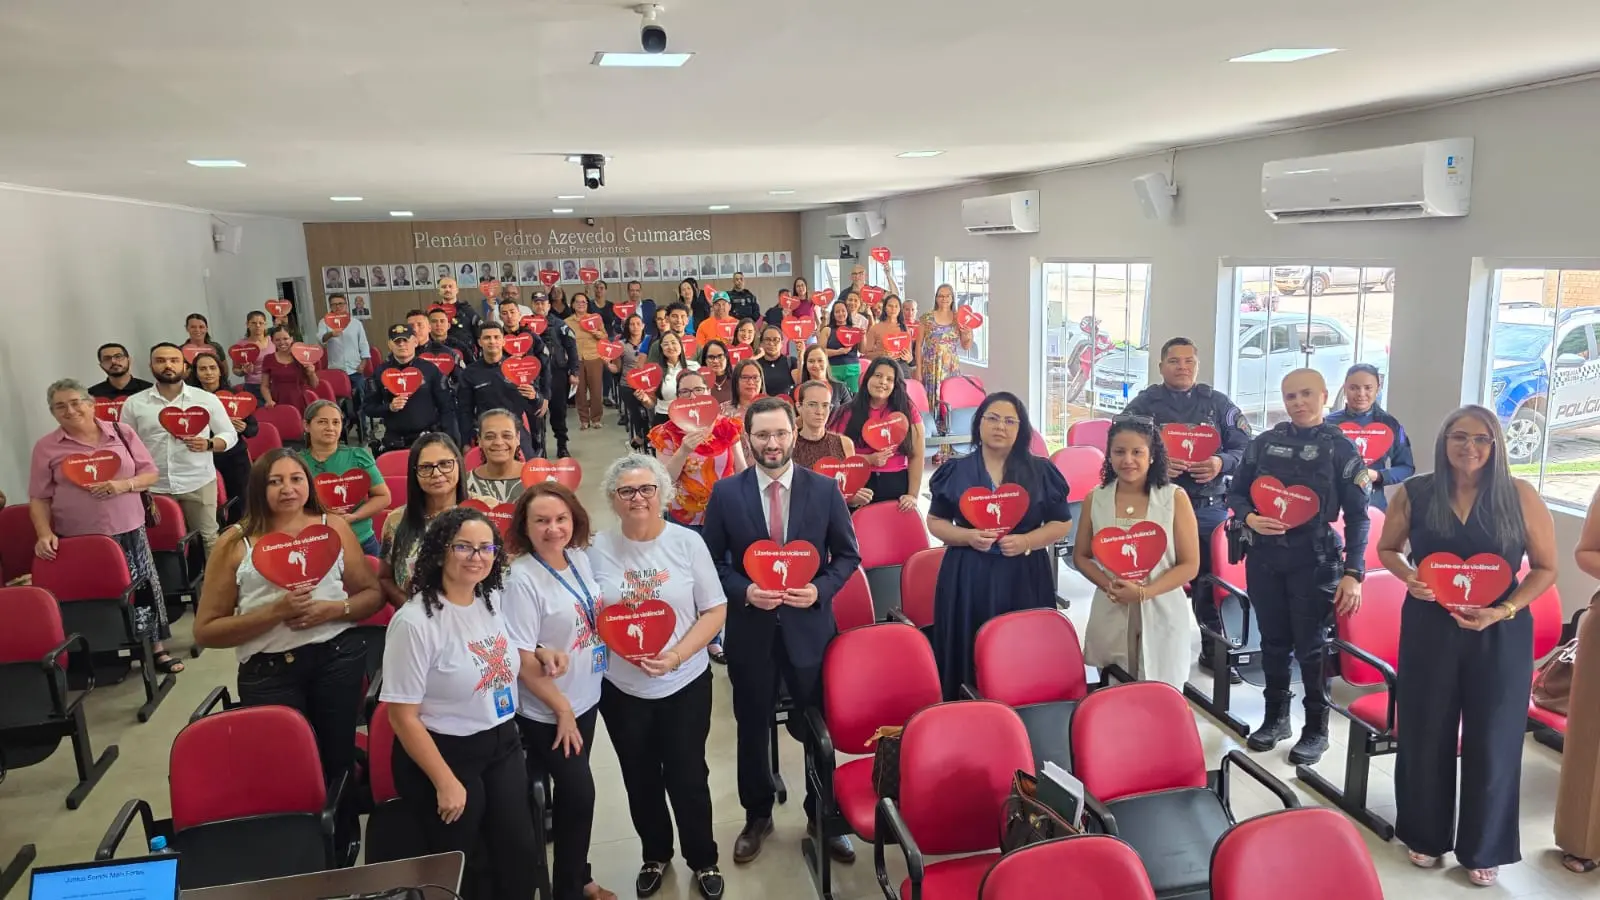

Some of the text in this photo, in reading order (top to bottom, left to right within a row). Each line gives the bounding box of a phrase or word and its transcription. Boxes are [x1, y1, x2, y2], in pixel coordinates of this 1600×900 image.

[414, 227, 710, 248] Plenário Pedro Azevedo Guimarães
[548, 246, 566, 254] dos
[569, 245, 630, 254] Presidentes
